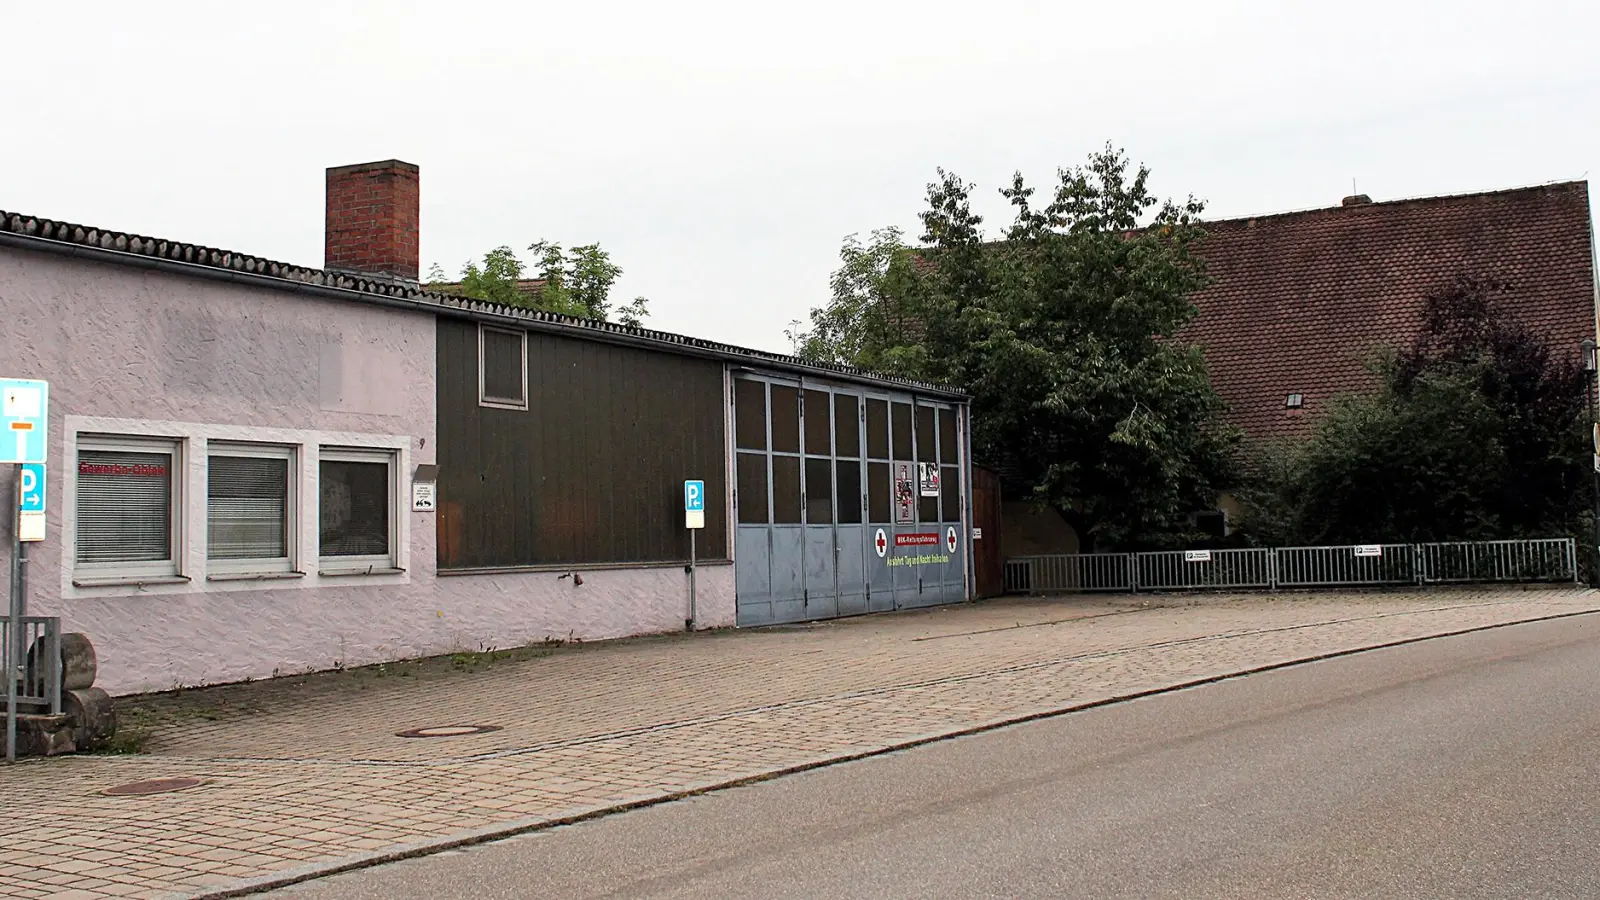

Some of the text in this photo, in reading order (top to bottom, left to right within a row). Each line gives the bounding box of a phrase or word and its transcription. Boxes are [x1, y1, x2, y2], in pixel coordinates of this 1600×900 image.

[20, 469, 37, 505] P
[687, 484, 699, 507] P
[887, 556, 904, 566] Ausfahrt
[904, 555, 912, 567] Tag
[911, 555, 919, 565] und
[919, 554, 931, 564] Nacht
